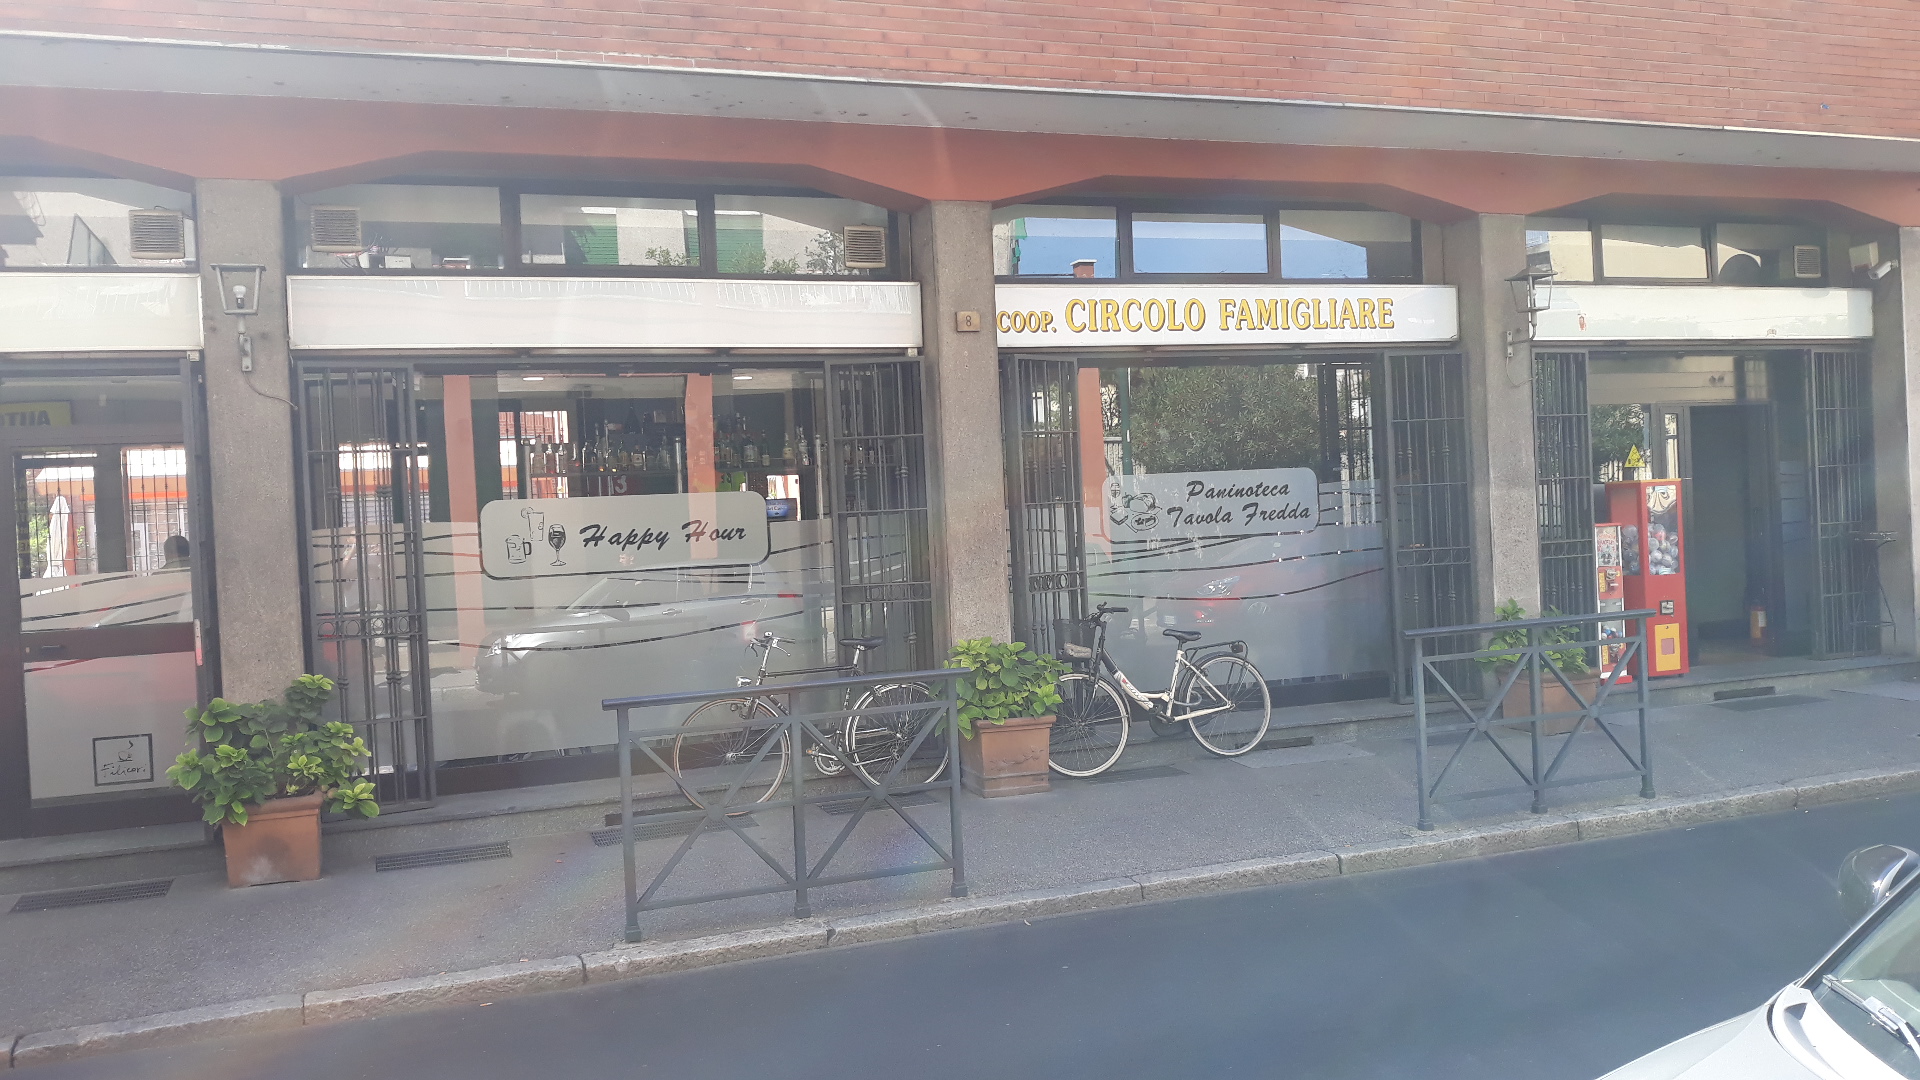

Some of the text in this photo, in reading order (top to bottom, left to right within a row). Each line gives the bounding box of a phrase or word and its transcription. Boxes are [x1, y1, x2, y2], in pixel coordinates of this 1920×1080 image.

[965, 315, 972, 327] 8
[996, 298, 1395, 333] COOP. CIRCOLO FAMIGLIARE
[1186, 480, 1290, 502] Paninoteca
[1166, 502, 1311, 528] Tavola Fredda
[579, 519, 747, 551] Happy Hour
